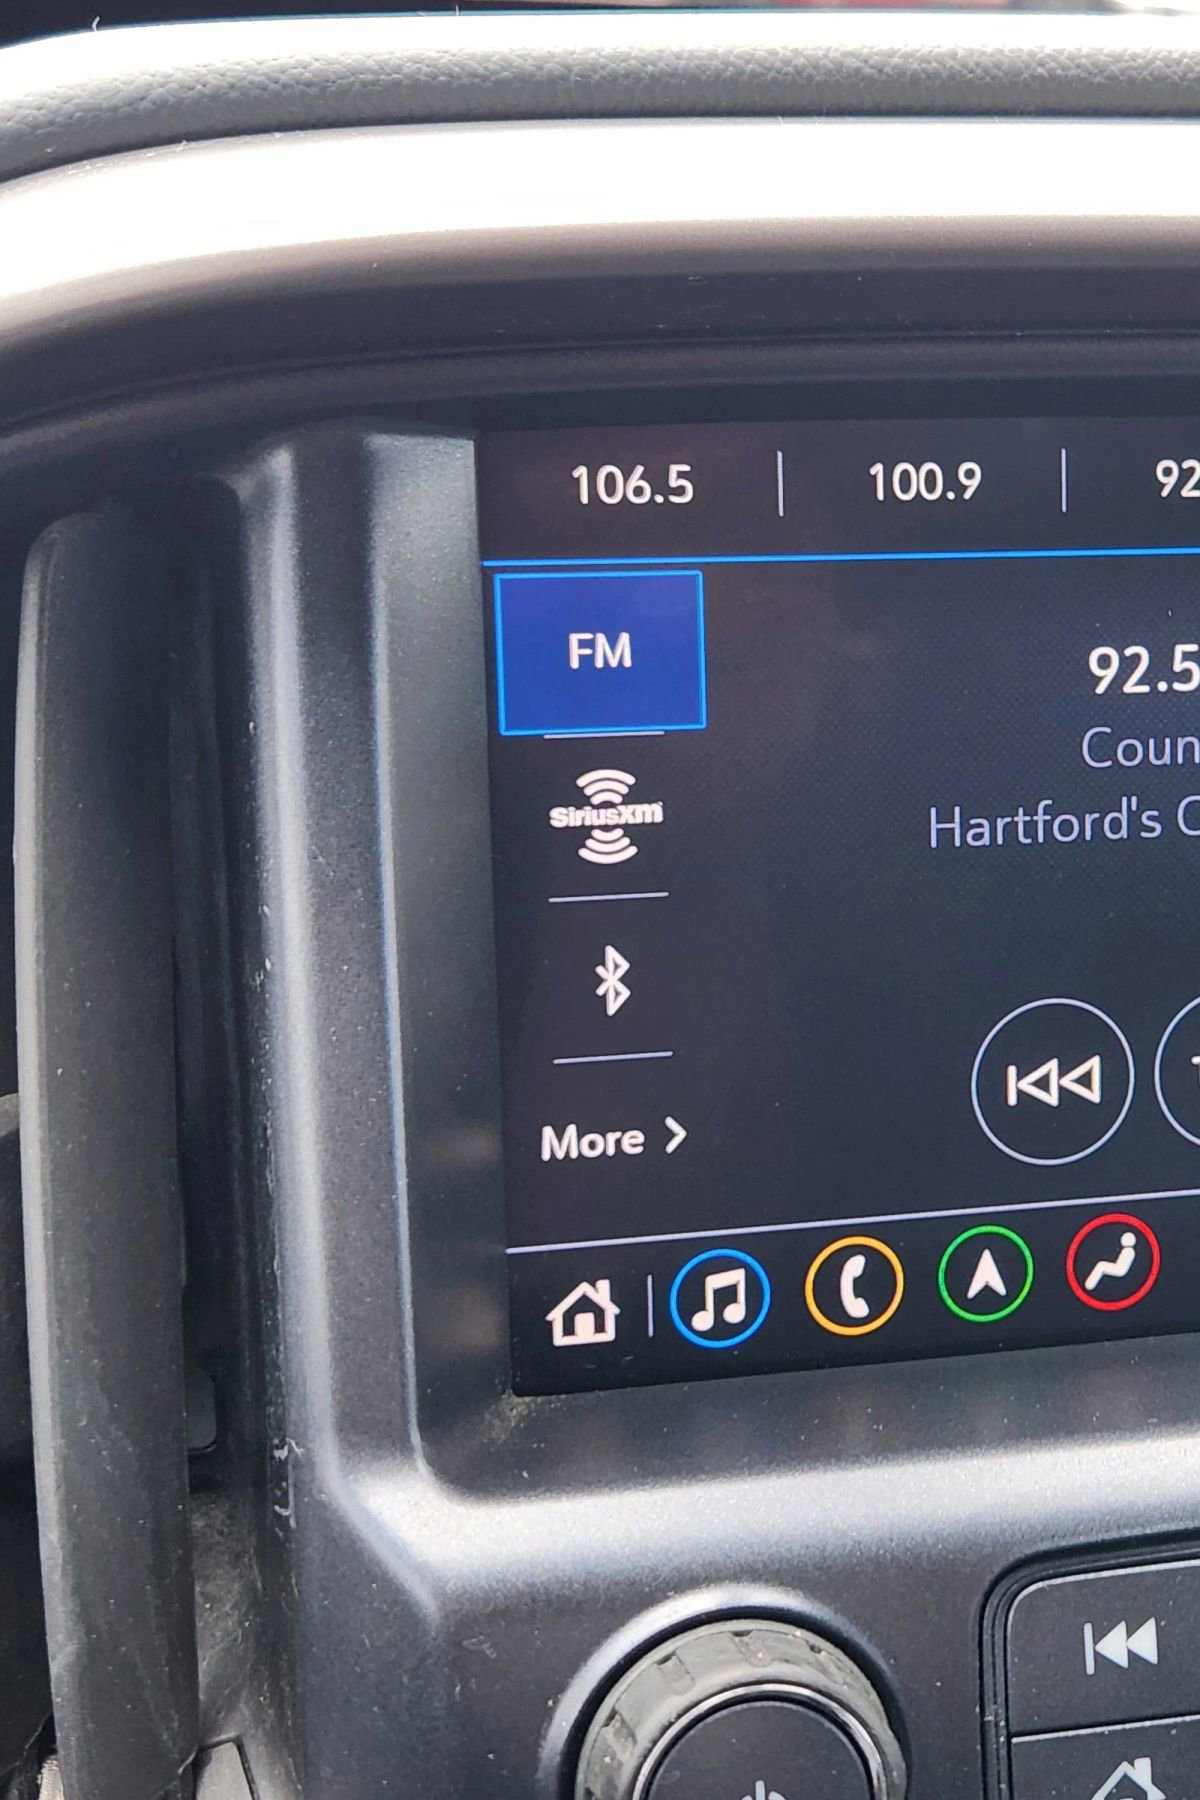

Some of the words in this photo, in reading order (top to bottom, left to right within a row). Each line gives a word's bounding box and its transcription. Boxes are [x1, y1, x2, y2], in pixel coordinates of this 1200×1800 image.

[571, 463, 694, 505] 106.5
[868, 460, 983, 503] 100.9
[567, 631, 633, 670] FM
[1087, 643, 1200, 695] 92.5
[930, 797, 1162, 850] Hartford's
[541, 1121, 645, 1163] More
